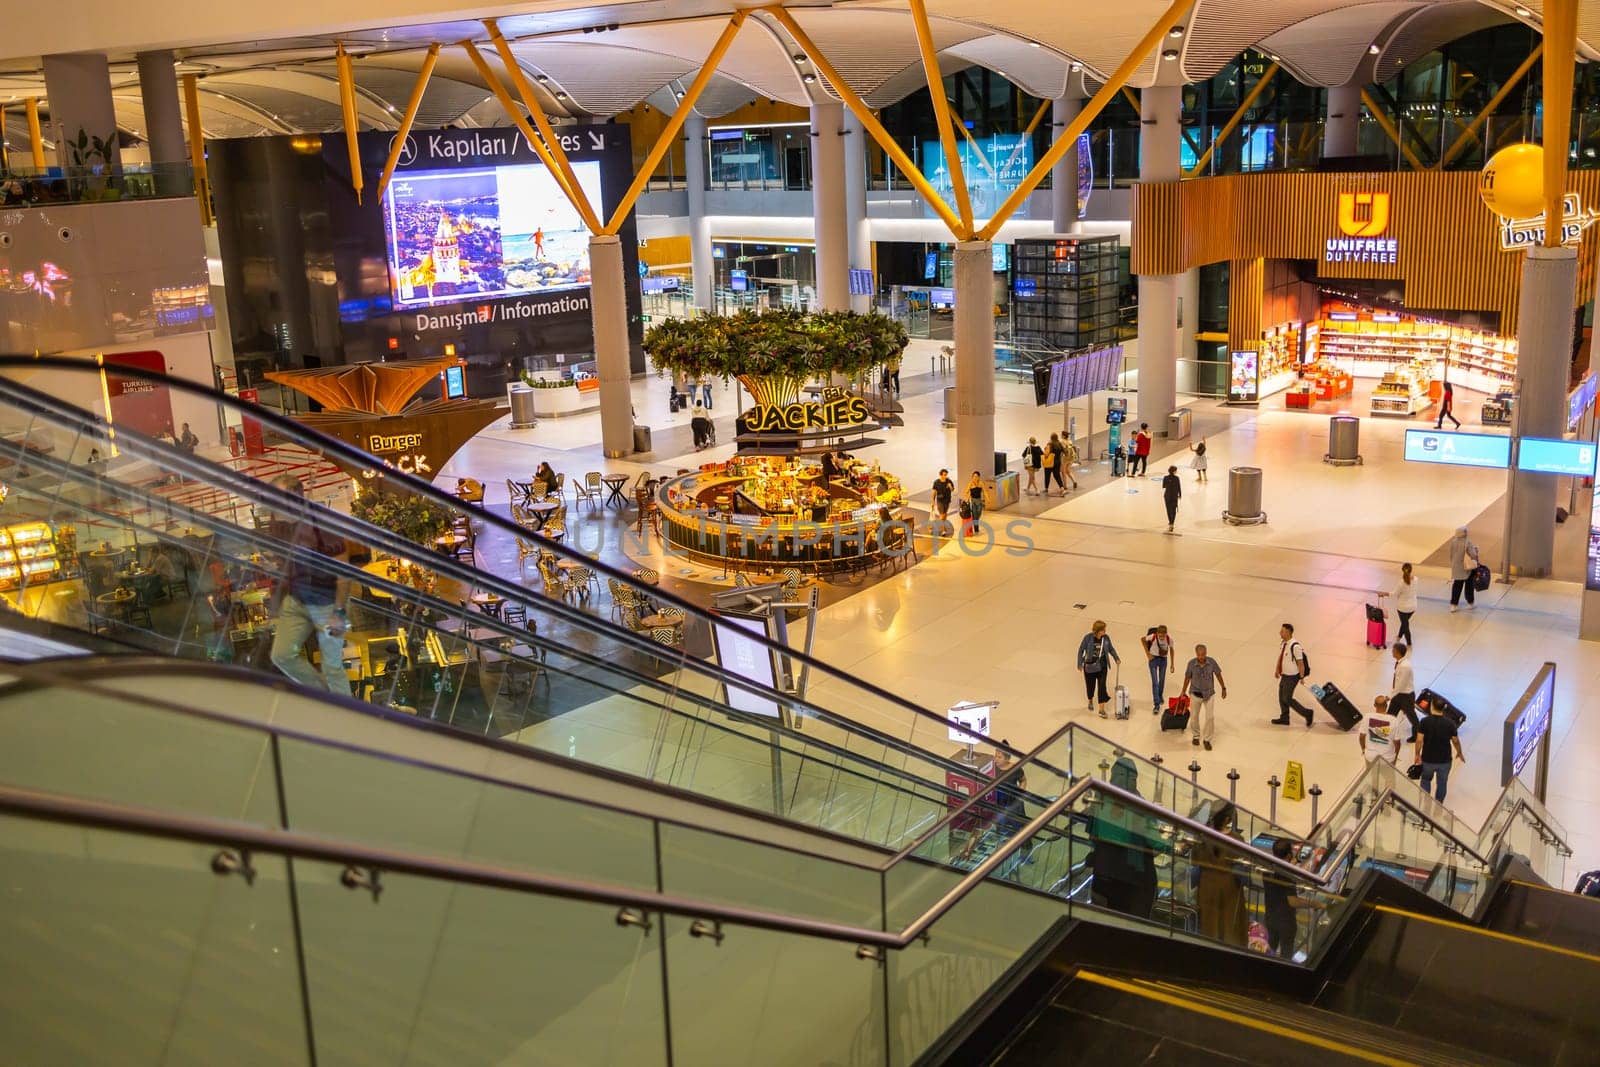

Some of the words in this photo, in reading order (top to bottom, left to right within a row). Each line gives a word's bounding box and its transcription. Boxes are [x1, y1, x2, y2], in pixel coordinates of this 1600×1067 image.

[429, 132, 506, 162] Kapıları
[1326, 239, 1397, 252] UNIFREE
[1326, 252, 1397, 263] DUTYFREE
[416, 307, 489, 331] Danışma
[500, 295, 589, 321] Information
[746, 397, 869, 431] JACKIES
[370, 433, 422, 451] Burger
[362, 455, 432, 479] JCK
